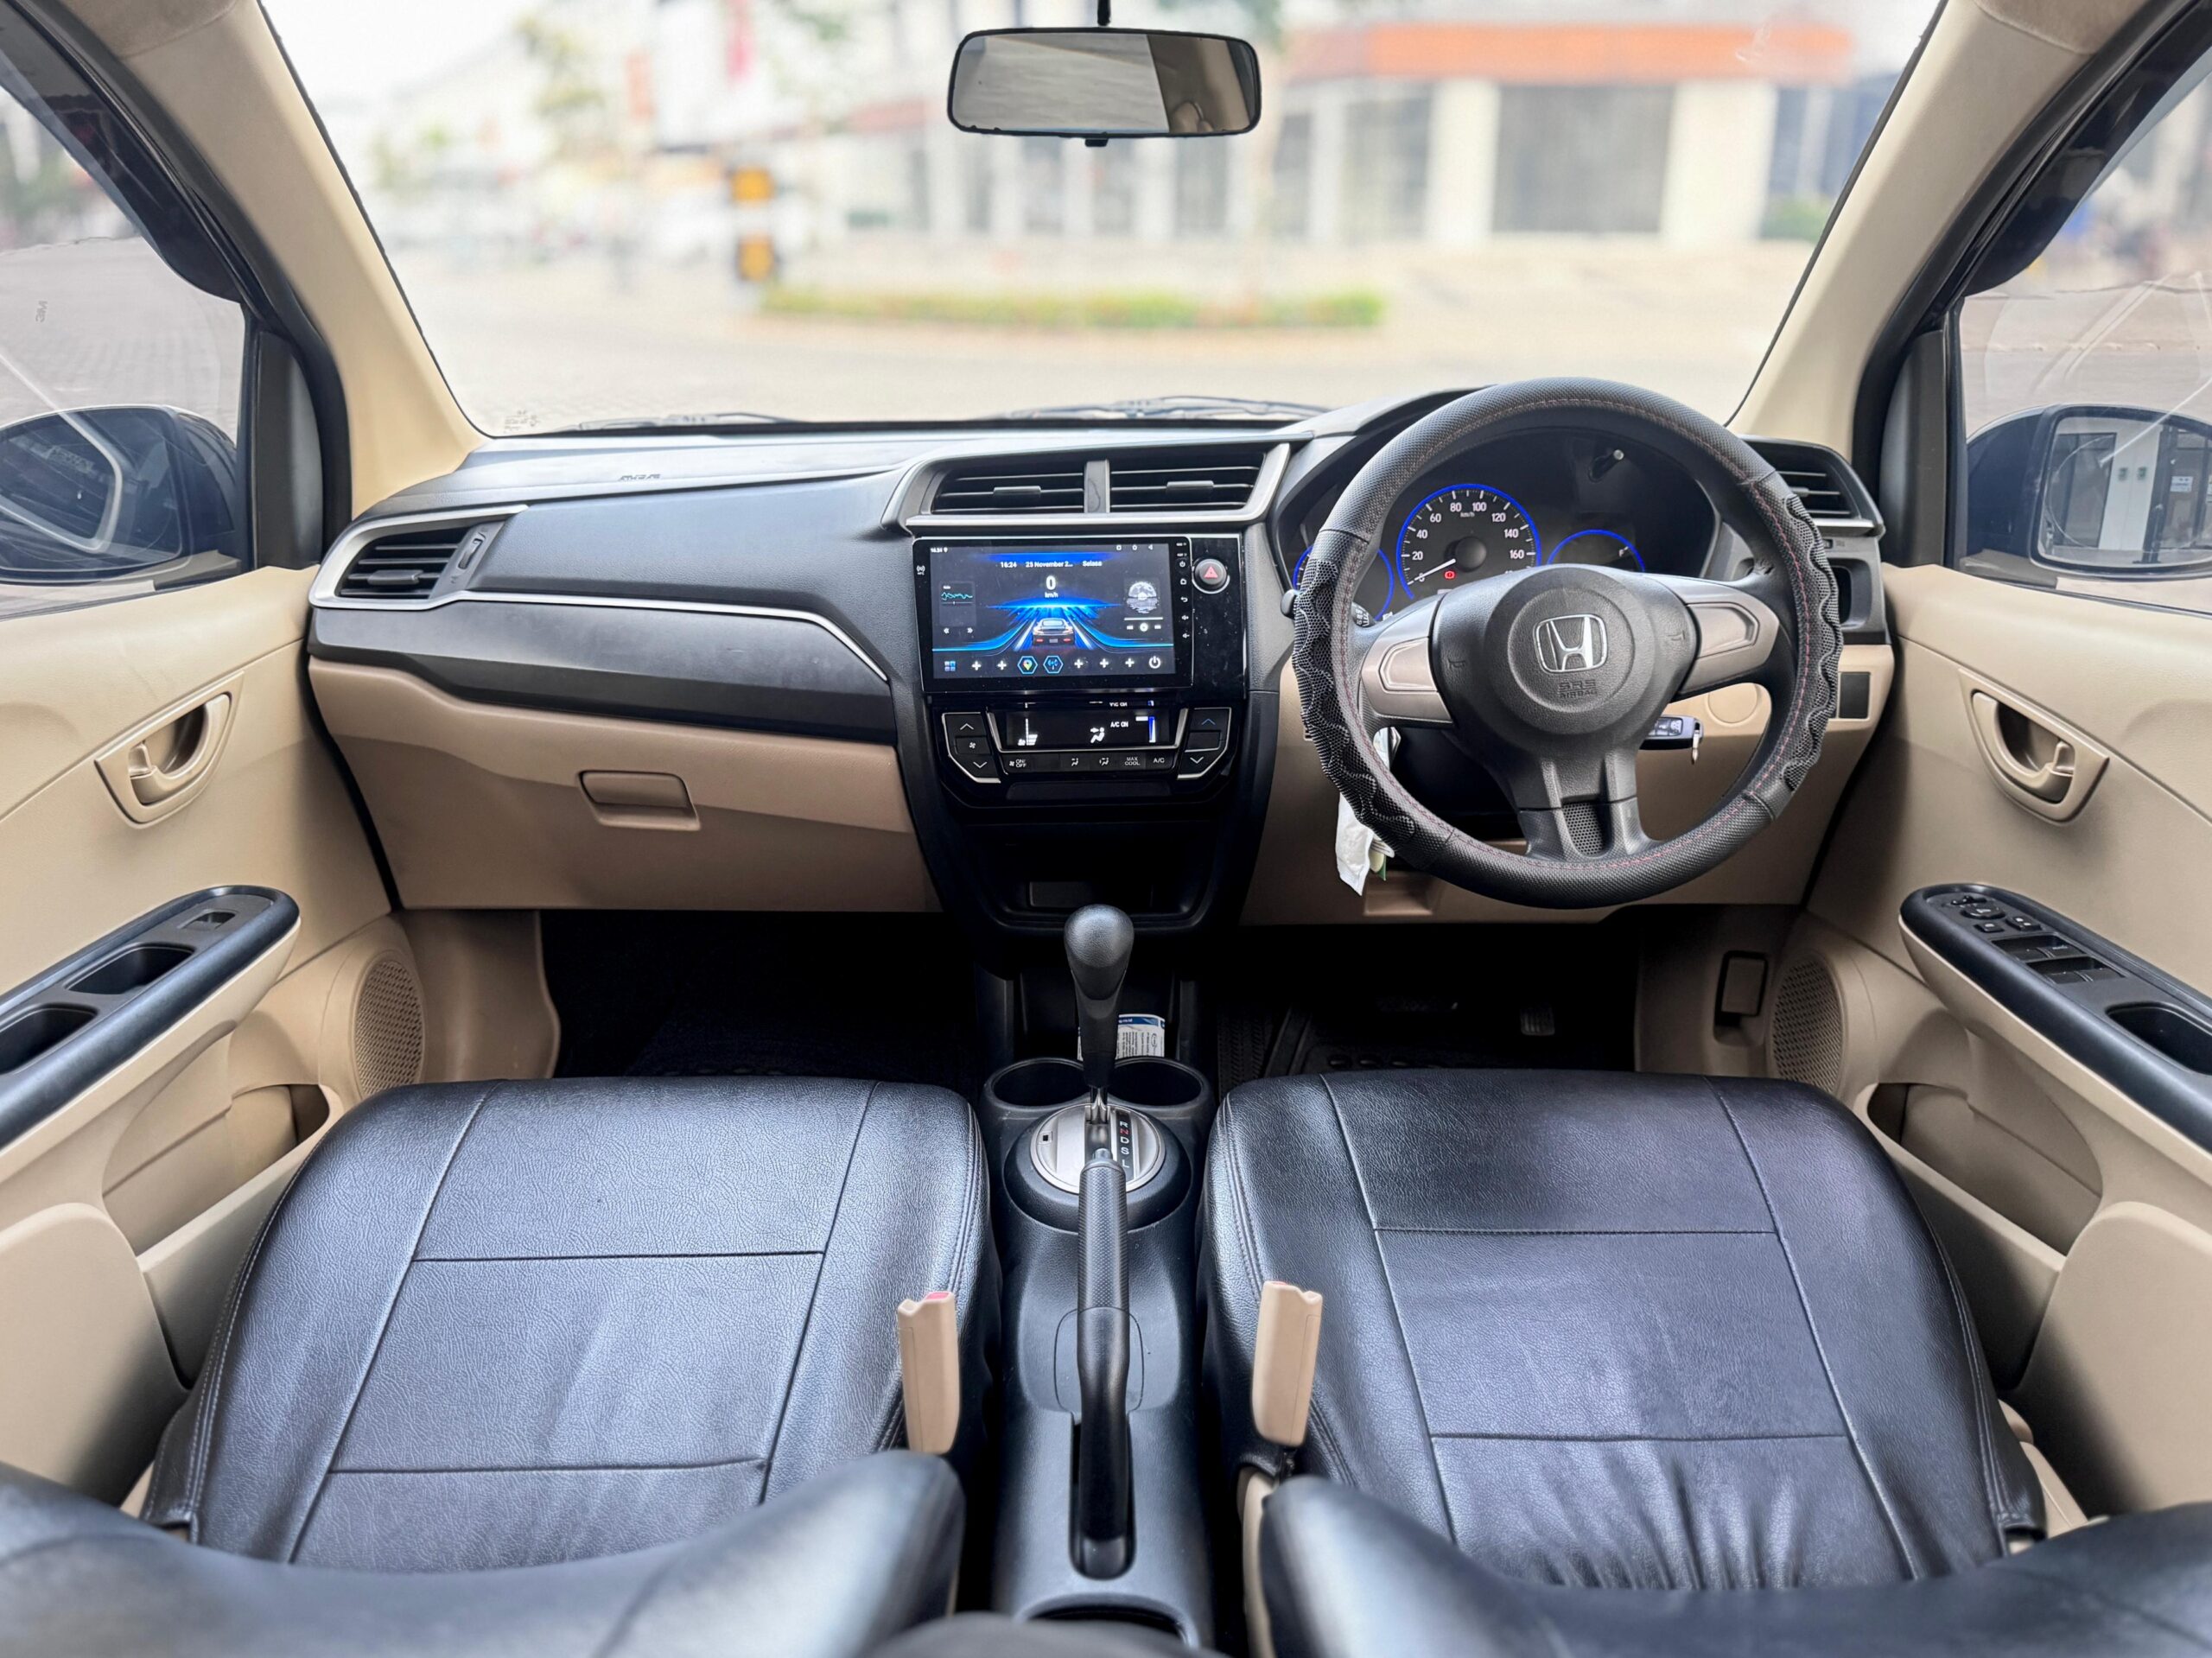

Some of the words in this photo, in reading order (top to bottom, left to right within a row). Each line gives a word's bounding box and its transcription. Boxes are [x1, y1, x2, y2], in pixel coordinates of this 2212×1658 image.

[1450, 502, 1462, 512] 80
[1472, 502, 1487, 512] 100
[1430, 512, 1442, 523] 60
[1491, 512, 1507, 523] 120
[1416, 529, 1428, 539] 40
[1503, 528, 1519, 538] 140
[1412, 550, 1424, 561] 20
[1510, 549, 1525, 559] 160
[1046, 575, 1057, 591] 0
[1559, 679, 1597, 690] SRS
[1121, 1147, 1130, 1155] S
[1122, 1159, 1130, 1168] L
